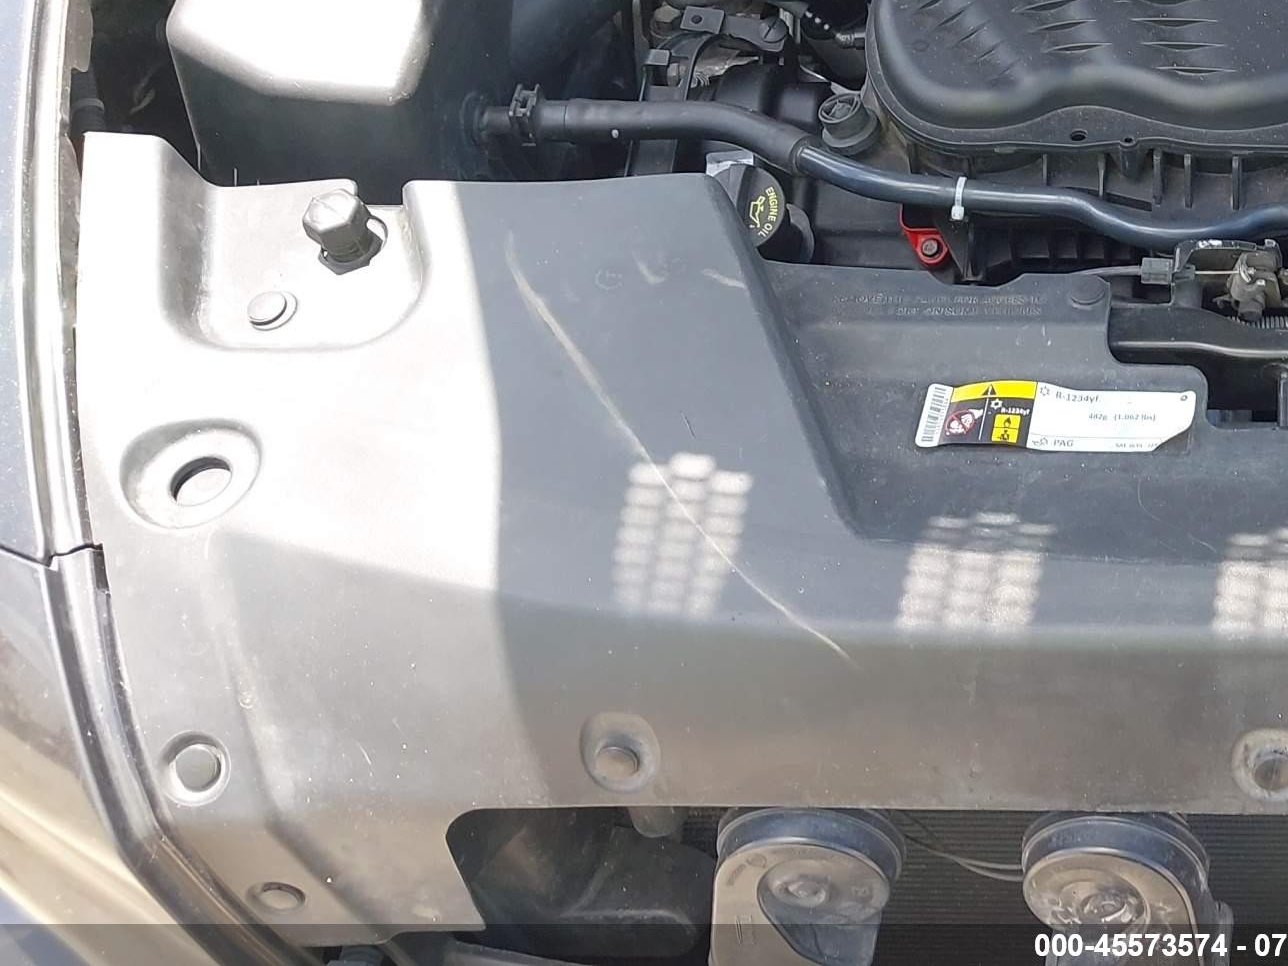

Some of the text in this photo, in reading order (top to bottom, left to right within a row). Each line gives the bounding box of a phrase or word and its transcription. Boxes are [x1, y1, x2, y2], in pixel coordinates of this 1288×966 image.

[757, 186, 779, 238] ENGINE OIL
[1055, 391, 1099, 404] R-1234yf
[1053, 439, 1075, 448] PAG
